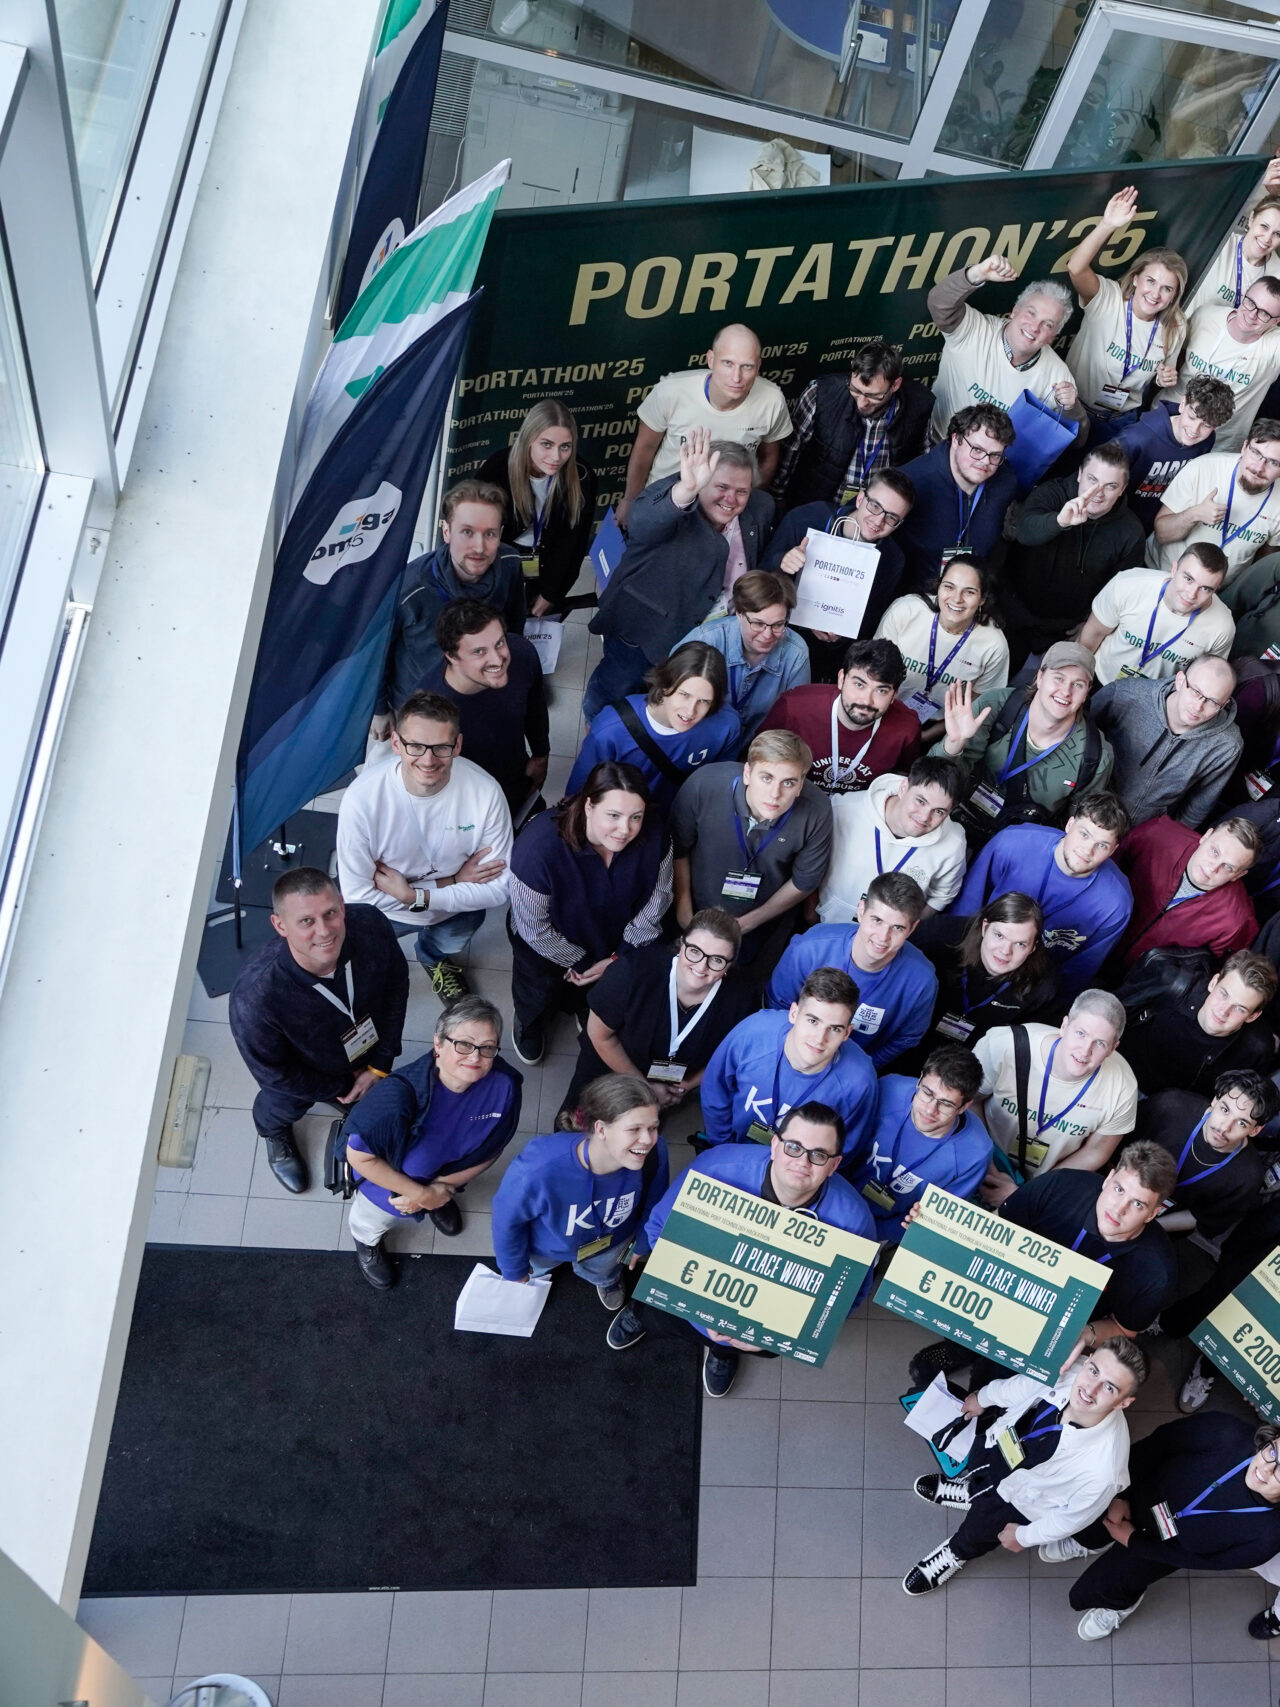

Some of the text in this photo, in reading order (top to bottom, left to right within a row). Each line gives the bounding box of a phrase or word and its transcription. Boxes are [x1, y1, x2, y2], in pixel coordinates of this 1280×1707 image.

[568, 210, 1158, 326] PORTATHON'25
[458, 358, 645, 397] PORTATHON'25
[568, 403, 614, 414] ORTATHON'25
[814, 559, 865, 580] PORTATHON'25
[820, 603, 845, 614] ignitis
[687, 1178, 828, 1247] PORTATHON 2025
[926, 1192, 1062, 1268] PORTATHON 2025
[680, 1260, 699, 1285] €
[703, 1269, 759, 1308] 1000
[730, 1242, 825, 1294] IV PLACE WINNER
[966, 1256, 1058, 1314] III PLACE WINNER
[918, 1270, 993, 1320] € 1000
[1232, 1323, 1253, 1344] €
